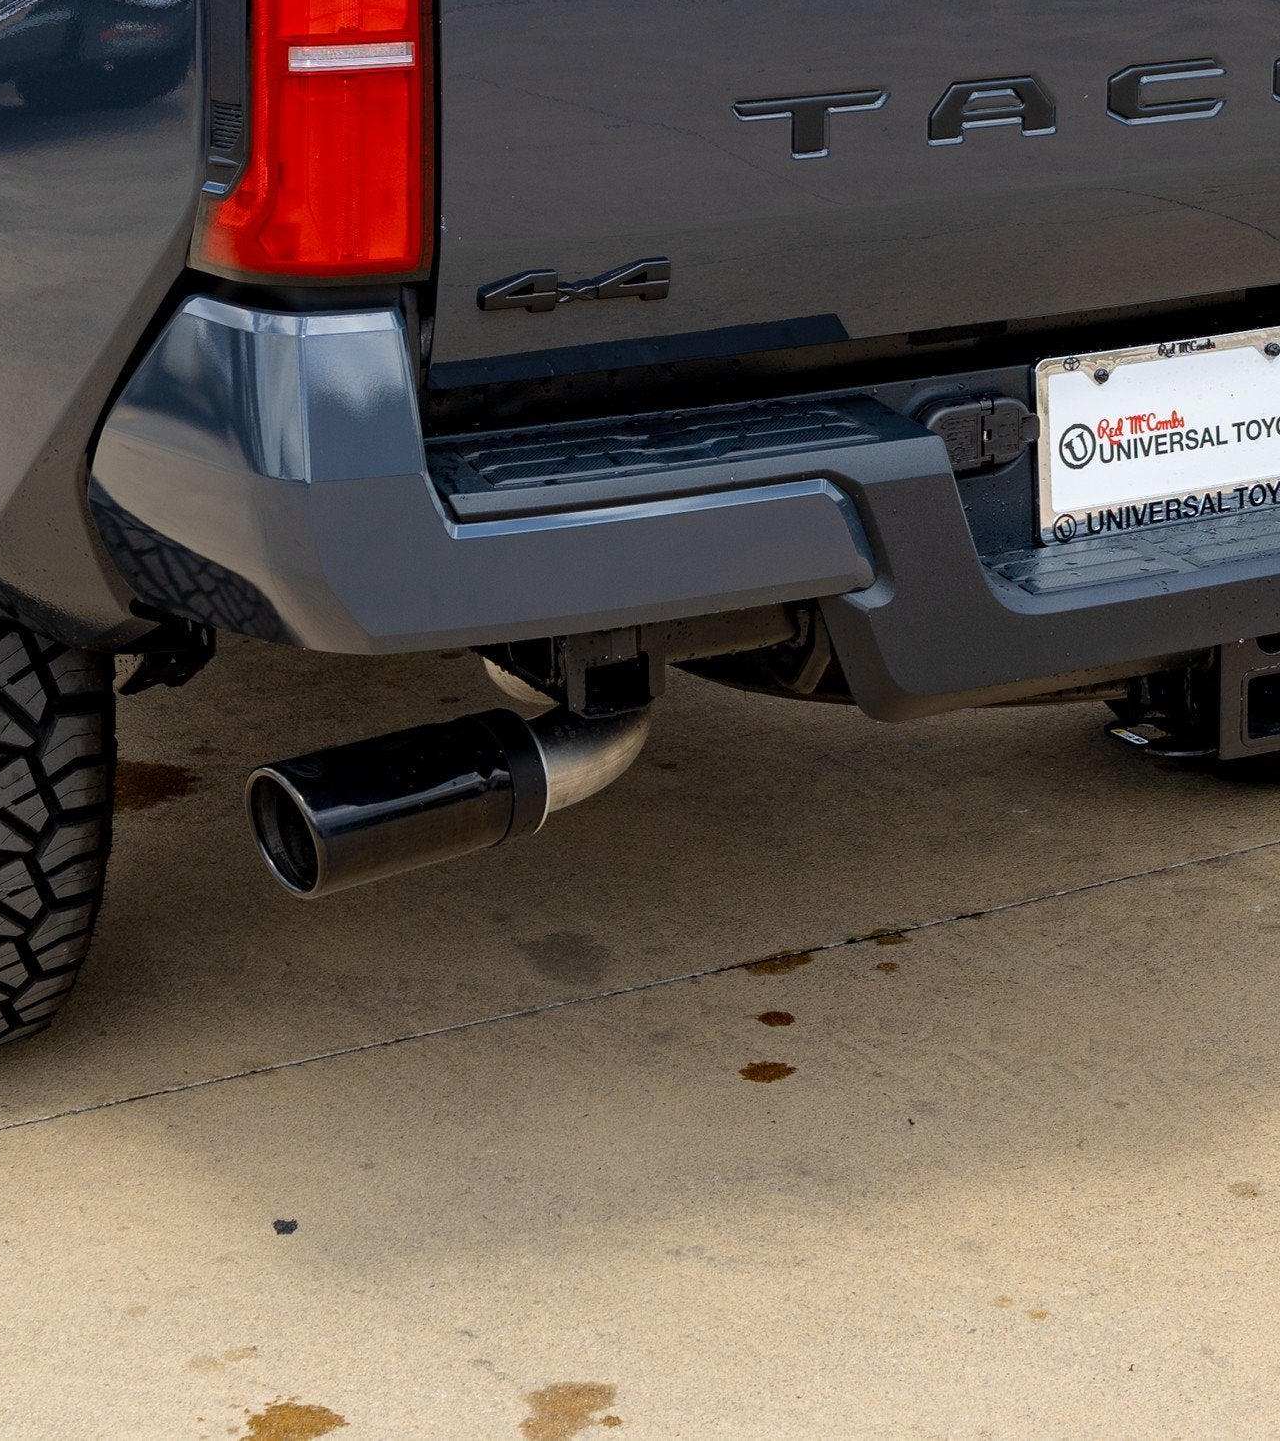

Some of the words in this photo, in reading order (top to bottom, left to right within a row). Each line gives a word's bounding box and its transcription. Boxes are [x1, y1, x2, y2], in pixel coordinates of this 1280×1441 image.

[1158, 343, 1176, 358] Red
[1097, 418, 1123, 445] Red
[1125, 410, 1186, 435] McCombs
[1099, 424, 1229, 464] UNIVERSAL
[1085, 490, 1231, 535] UNIVERSAL
